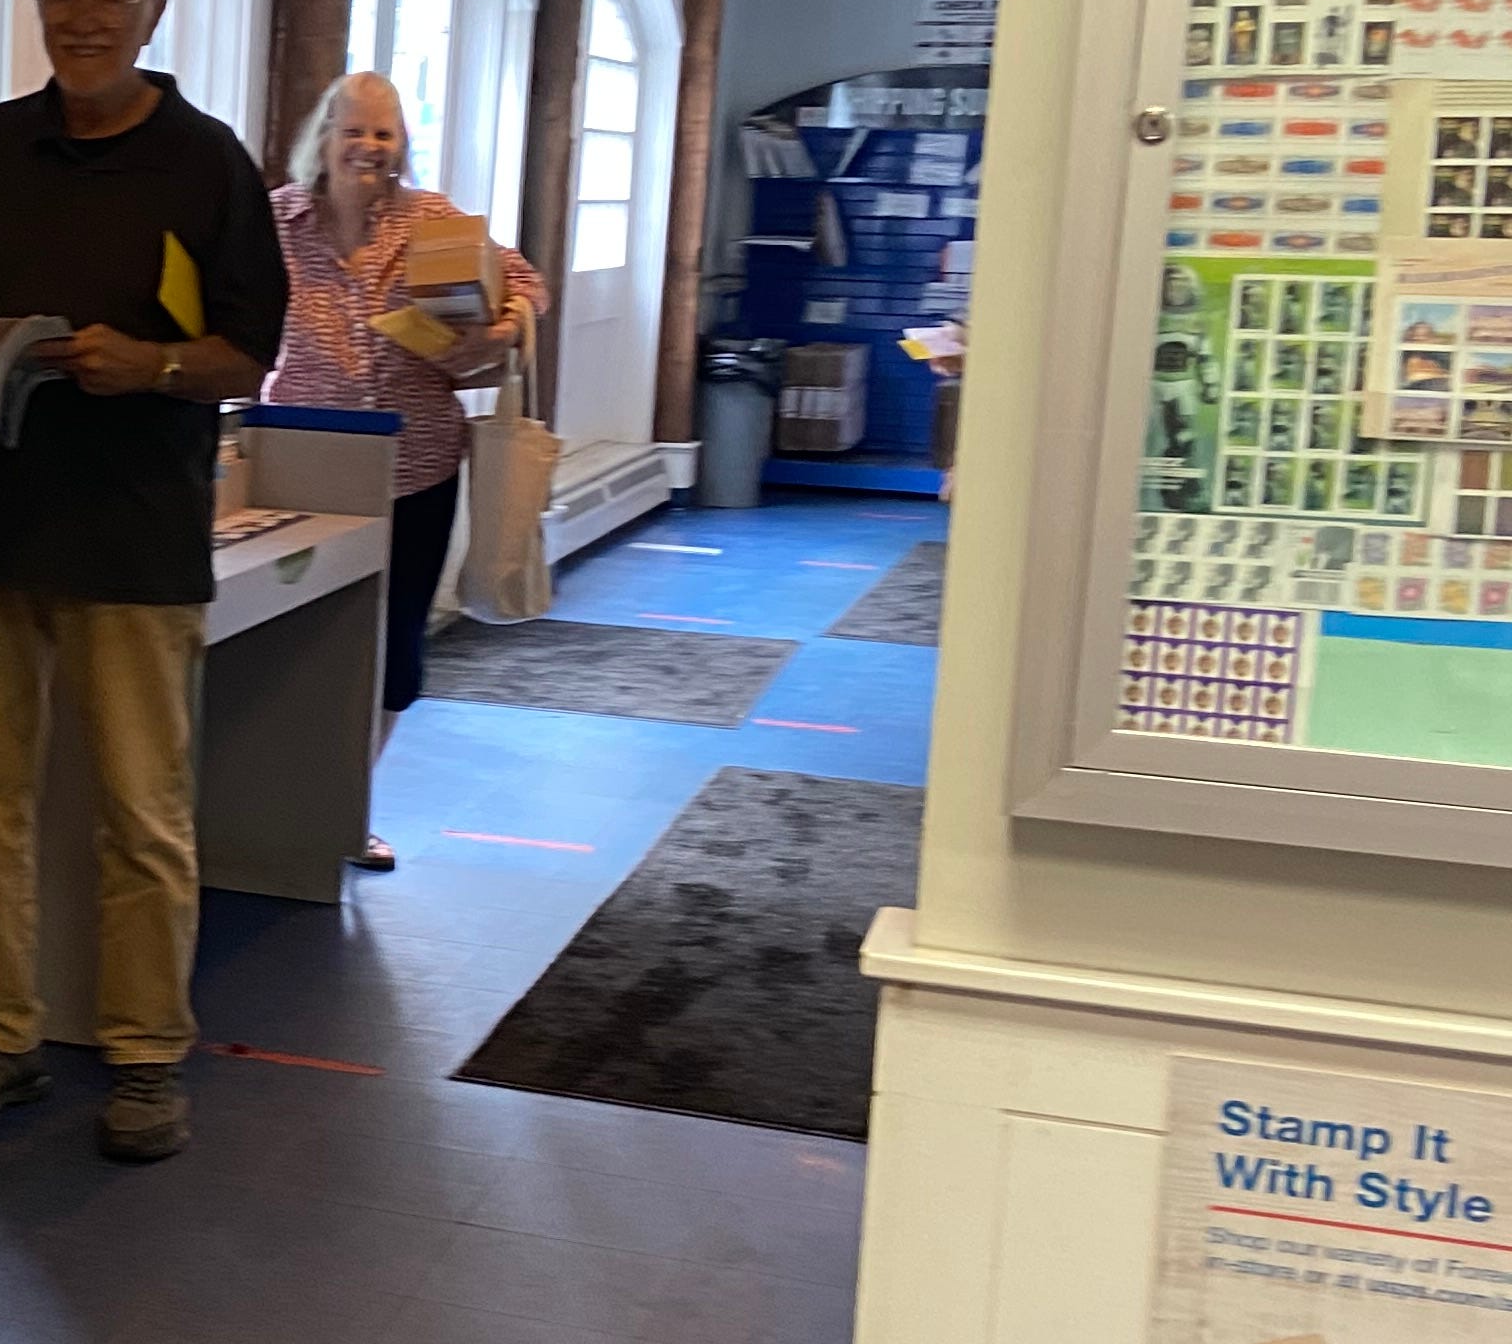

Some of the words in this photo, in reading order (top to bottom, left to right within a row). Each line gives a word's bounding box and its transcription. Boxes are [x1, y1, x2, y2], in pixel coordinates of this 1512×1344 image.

[1218, 1099, 1392, 1161] Stamp
[1413, 1123, 1452, 1164] It
[1214, 1151, 1335, 1202] With
[1355, 1170, 1496, 1223] Style
